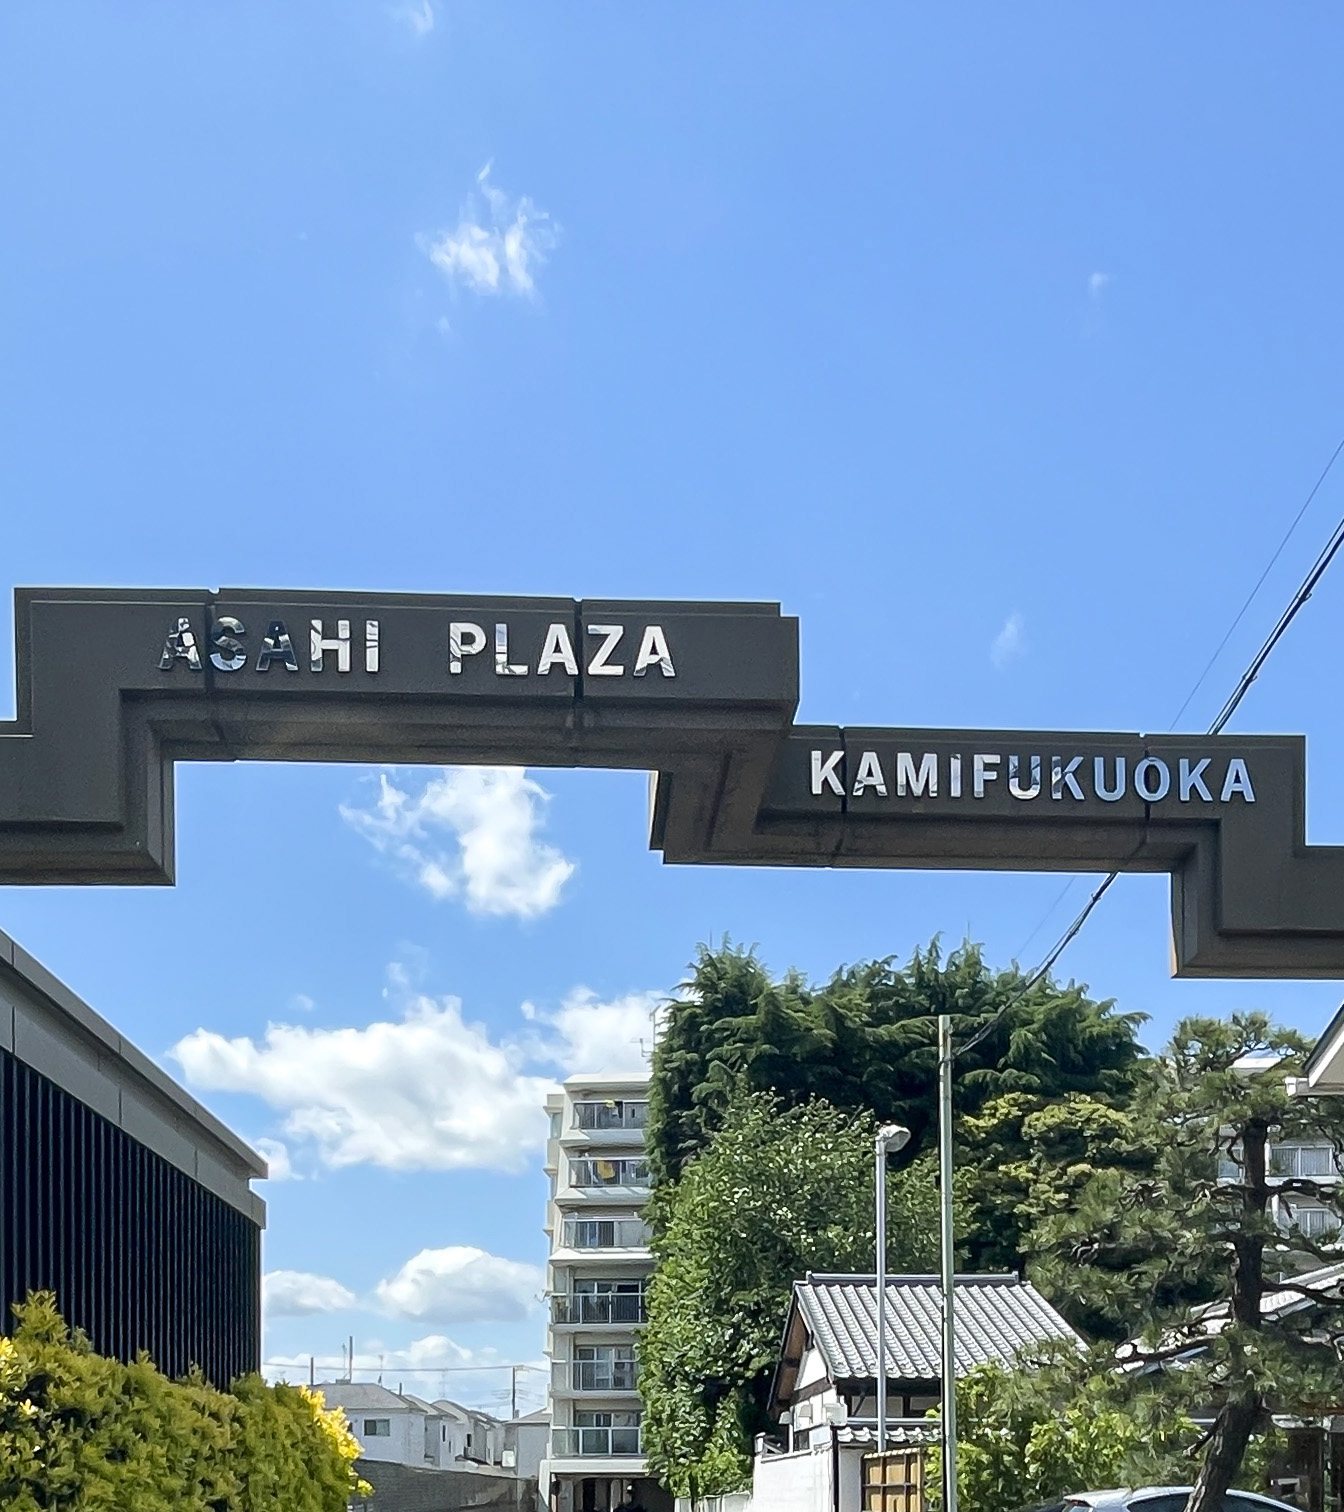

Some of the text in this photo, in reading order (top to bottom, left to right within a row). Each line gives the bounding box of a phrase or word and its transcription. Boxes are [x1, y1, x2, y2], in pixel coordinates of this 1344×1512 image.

[155, 615, 678, 679] ASAHI PLAZA
[809, 749, 1257, 804] KAMIFUKUOKA
